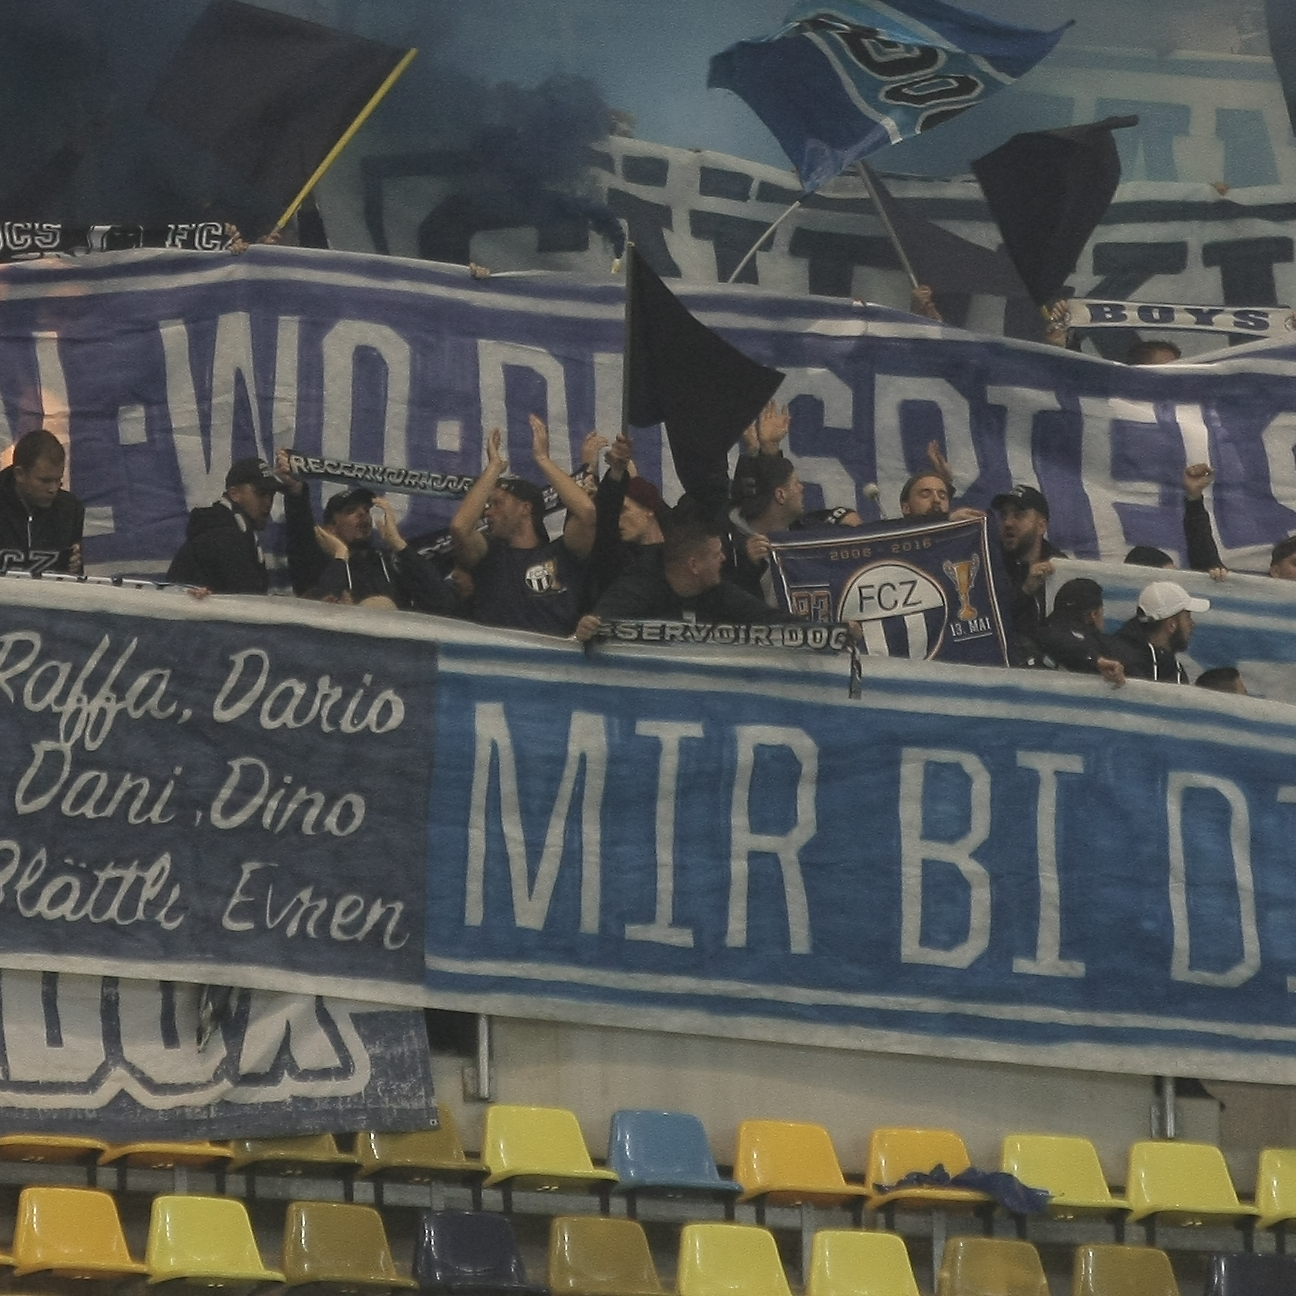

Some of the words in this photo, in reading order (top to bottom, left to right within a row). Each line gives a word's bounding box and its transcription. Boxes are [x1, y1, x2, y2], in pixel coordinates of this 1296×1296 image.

[1087, 308, 1271, 337] BOYS
[857, 579, 923, 613] FCZ
[211, 647, 407, 734] Dario
[209, 756, 366, 837] Dino
[454, 704, 819, 959] MIR
[896, 746, 1089, 979] BI
[220, 859, 412, 953] Evren
